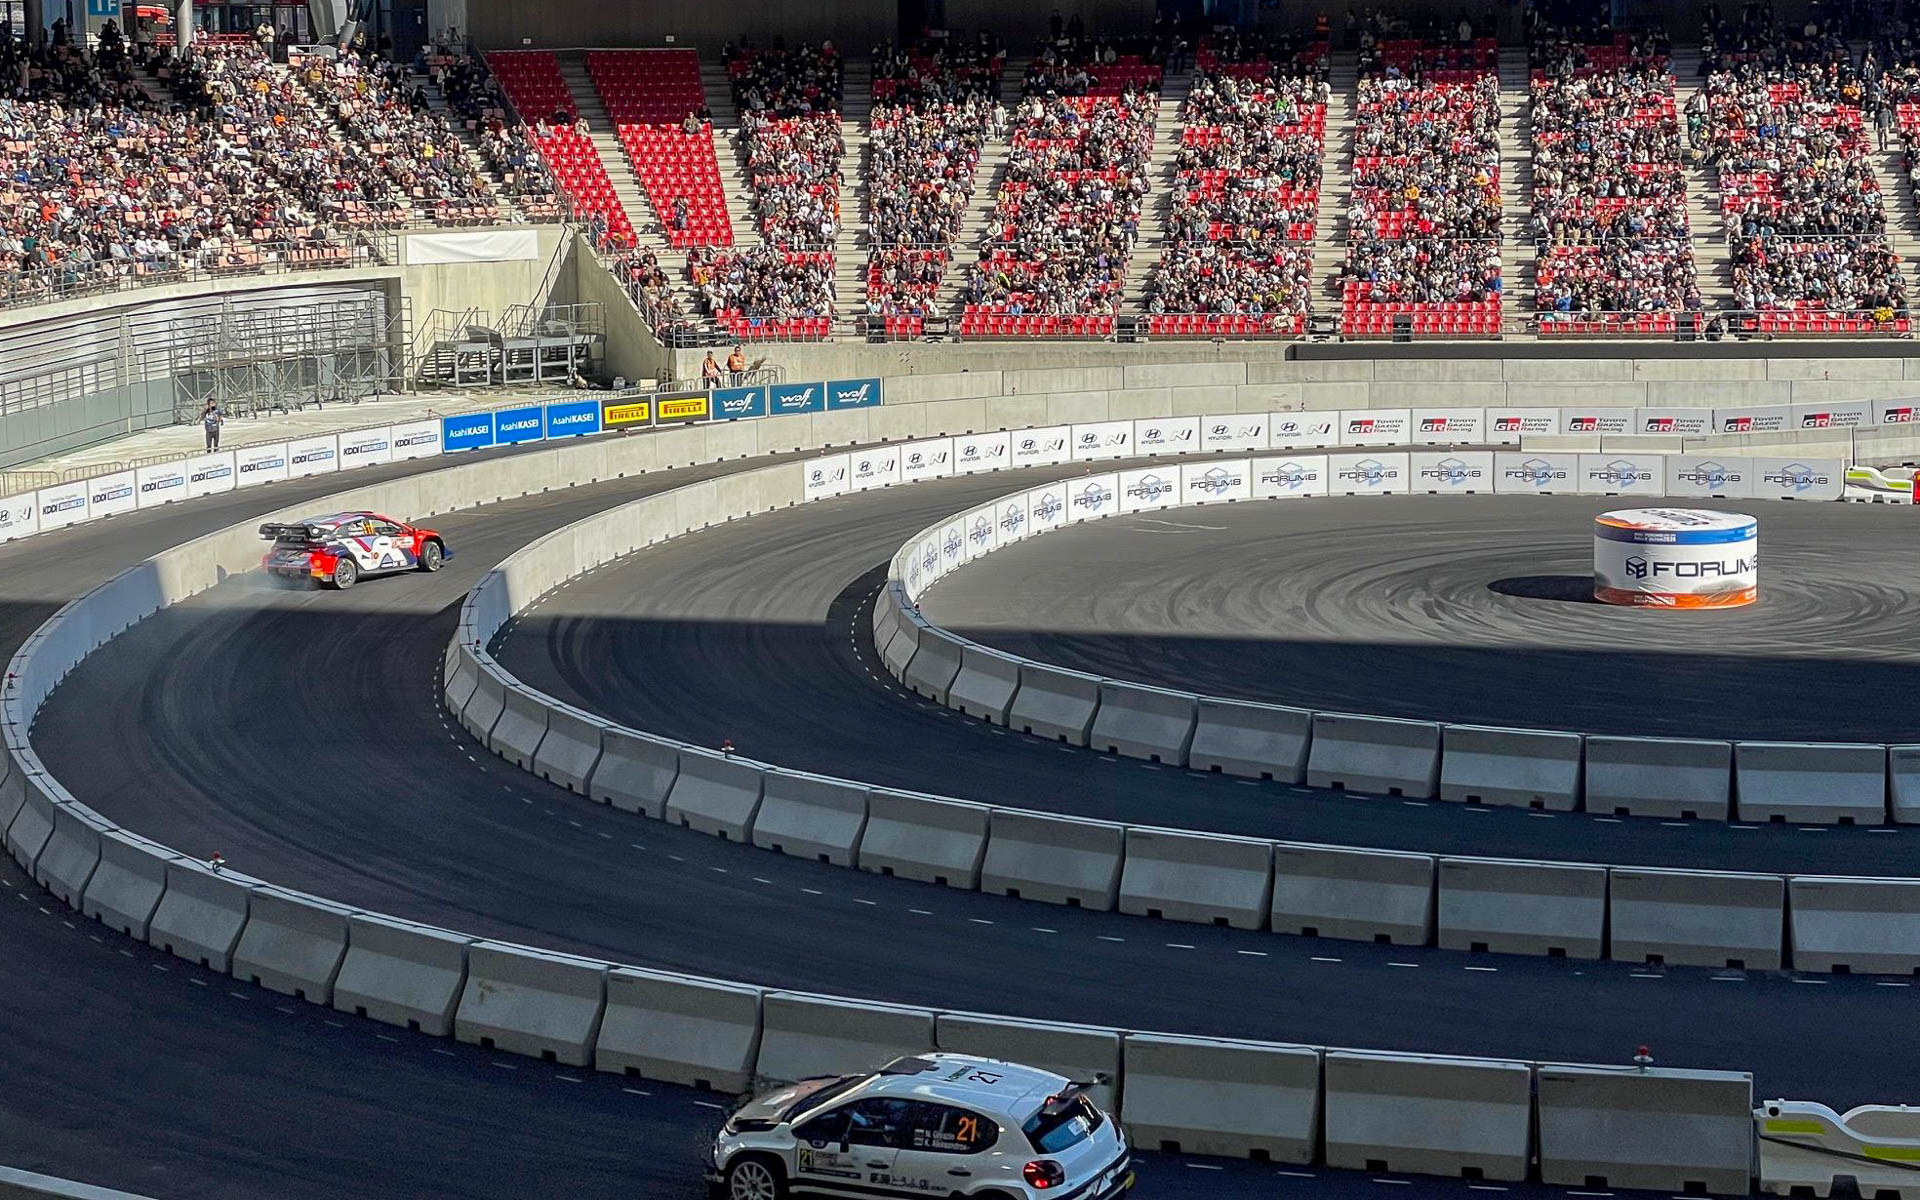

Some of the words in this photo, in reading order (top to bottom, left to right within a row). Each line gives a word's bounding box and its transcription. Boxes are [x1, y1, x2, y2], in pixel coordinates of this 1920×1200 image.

[609, 406, 645, 420] PIRELLI
[664, 401, 702, 415] PIRELLI
[1262, 473, 1317, 483] FORUM8
[1339, 471, 1397, 479] FORUM8
[1505, 471, 1566, 479] FORUM8
[1589, 472, 1651, 480] FORUM8
[1678, 473, 1741, 482] FORUM8
[1764, 475, 1828, 485] FORUM8
[1191, 478, 1242, 490] FORUM8
[1127, 485, 1172, 497] FORUM8
[968, 1070, 1004, 1084] 21
[957, 1116, 977, 1142] 21
[800, 1150, 814, 1166] 21
